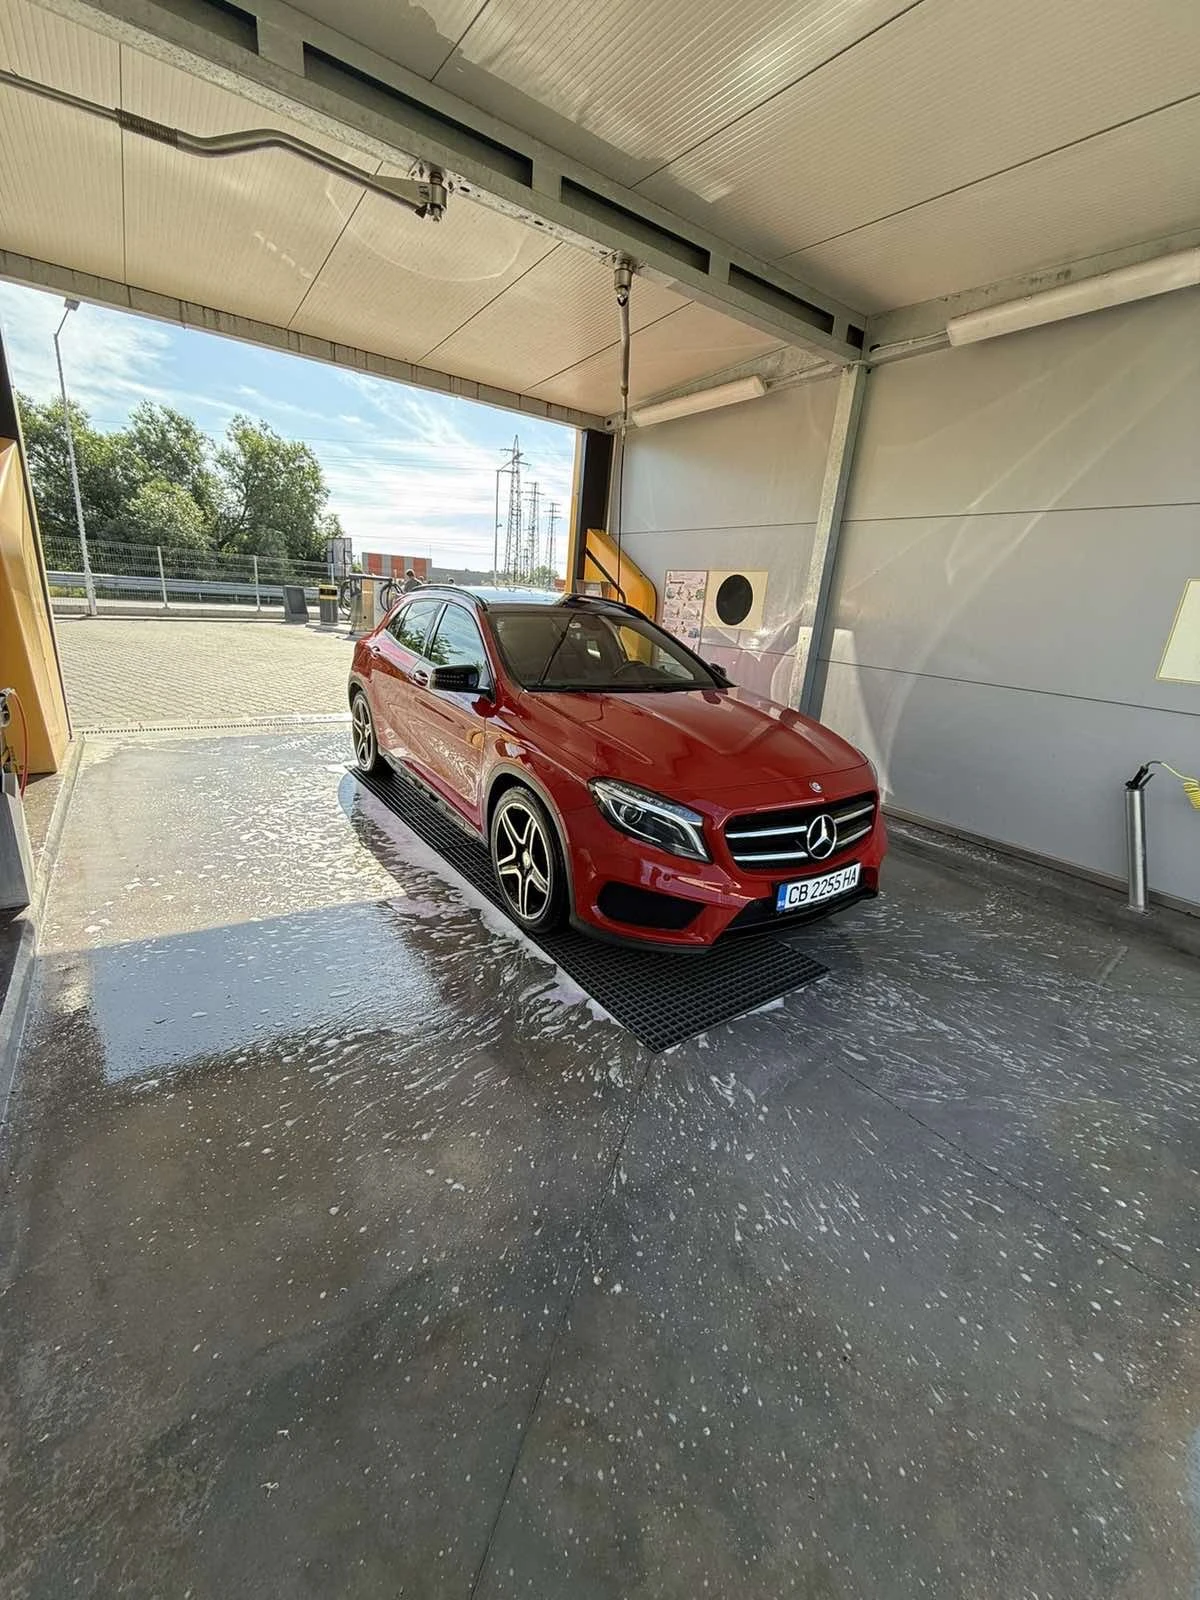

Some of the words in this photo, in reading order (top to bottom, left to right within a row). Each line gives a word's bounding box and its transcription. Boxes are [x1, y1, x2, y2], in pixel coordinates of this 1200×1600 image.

[789, 884, 808, 904] CB
[810, 873, 842, 899] 2255
[842, 867, 856, 888] HA
